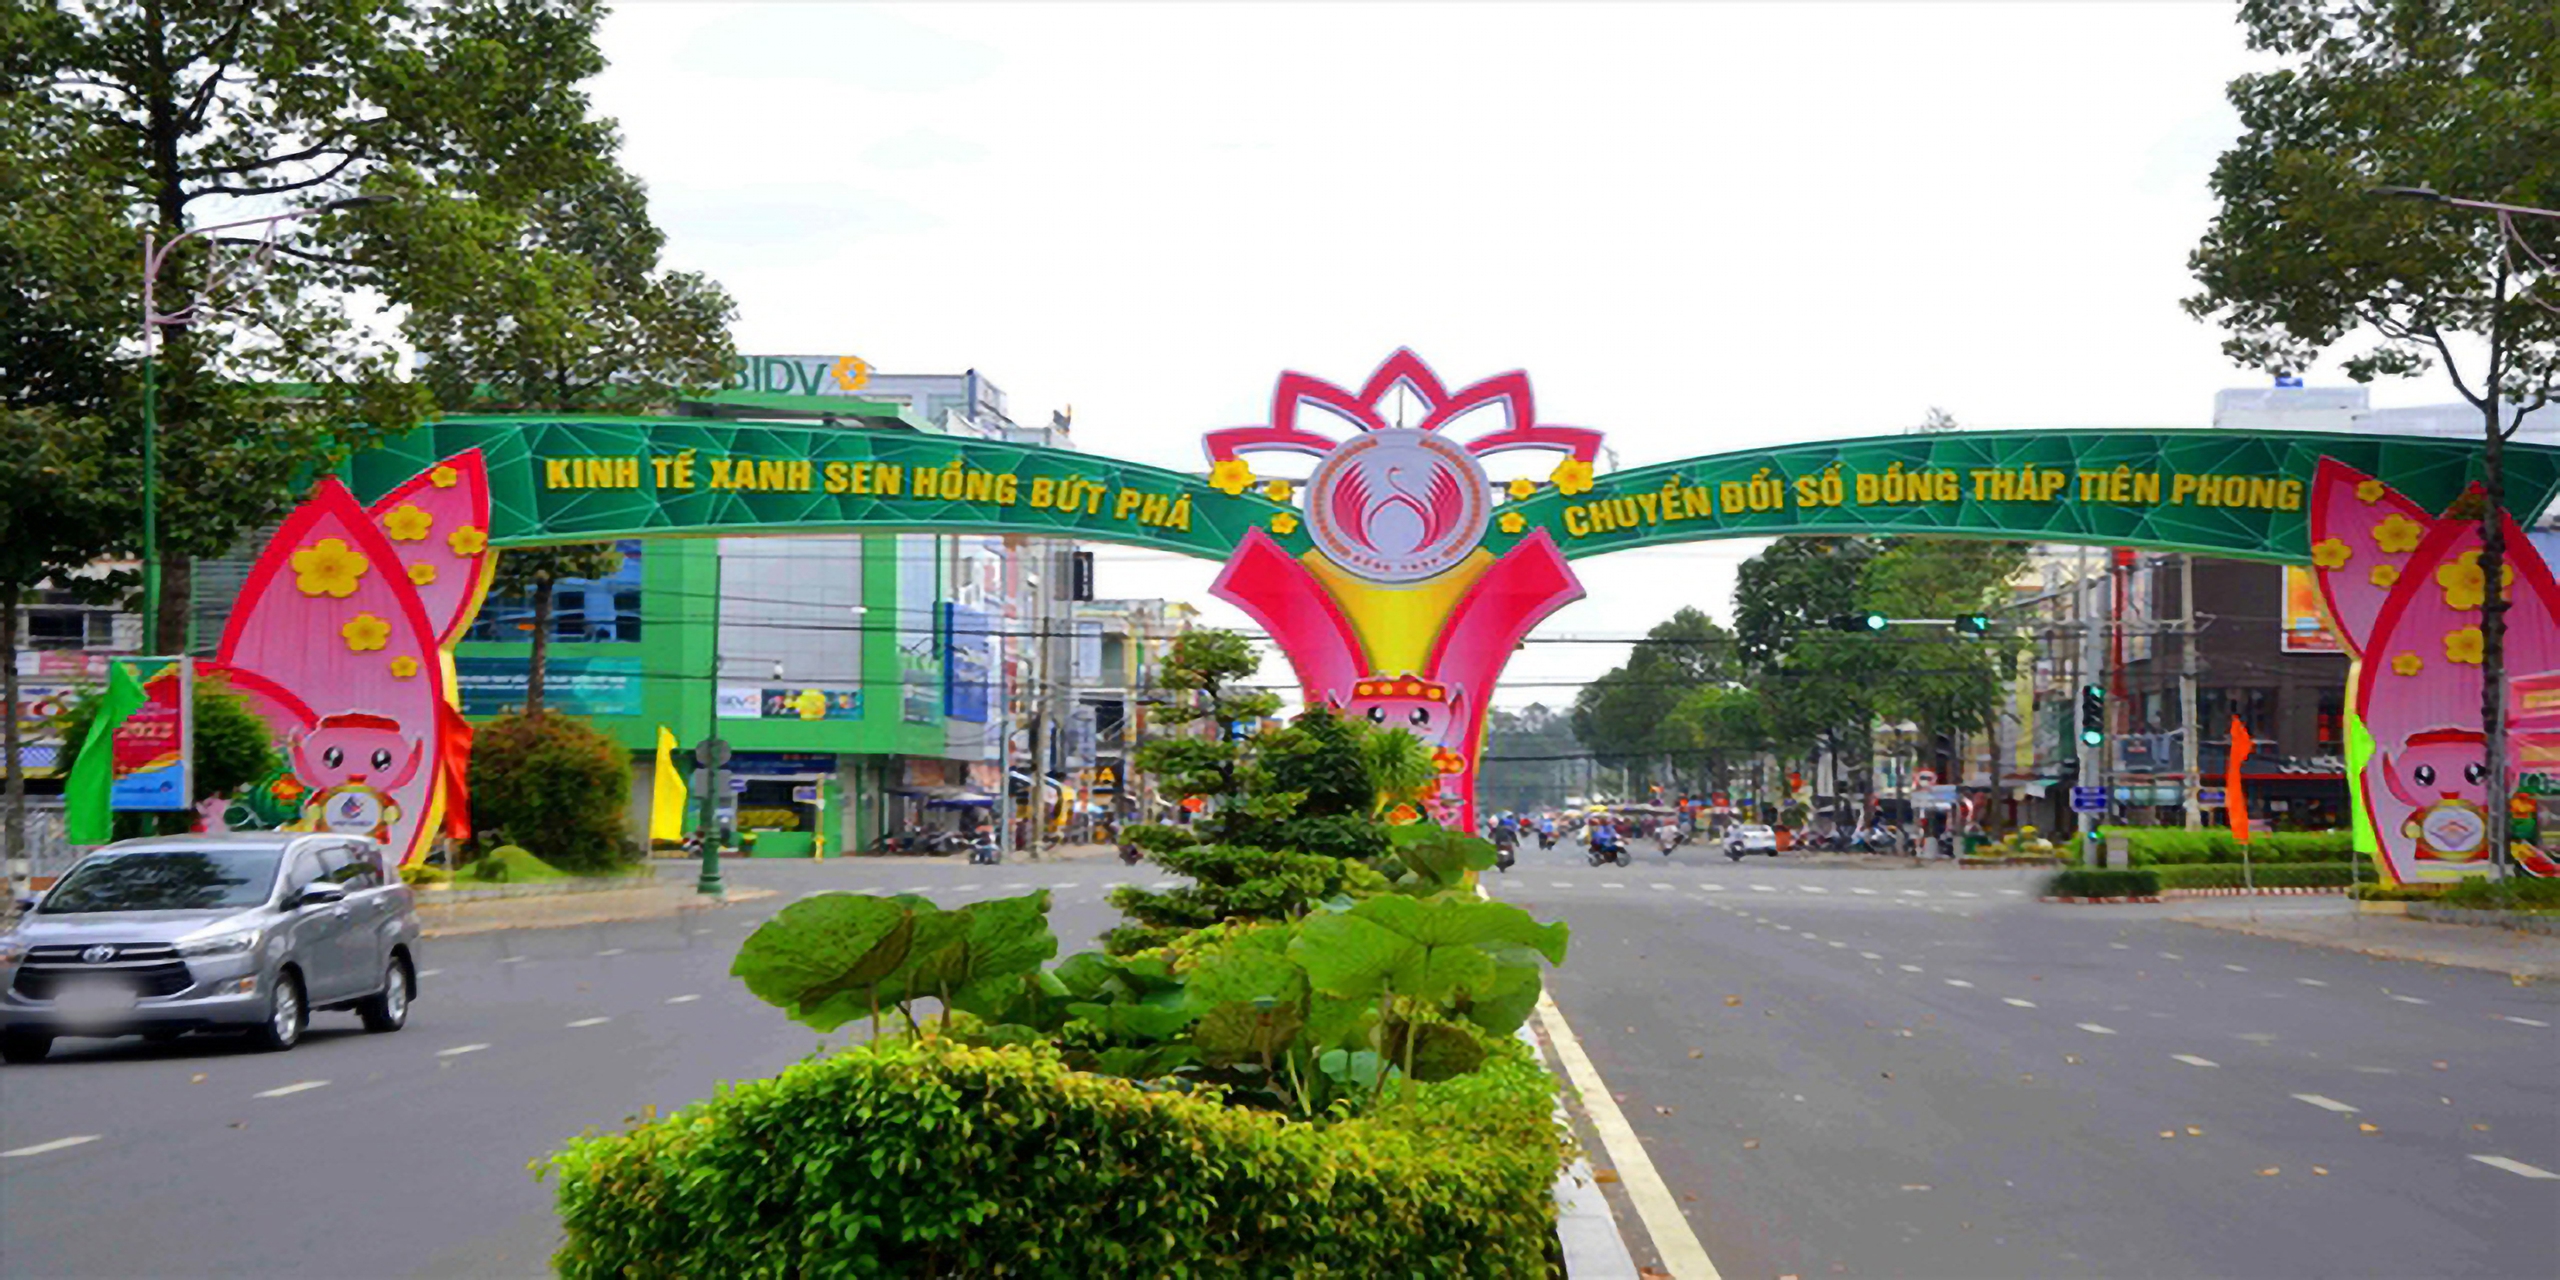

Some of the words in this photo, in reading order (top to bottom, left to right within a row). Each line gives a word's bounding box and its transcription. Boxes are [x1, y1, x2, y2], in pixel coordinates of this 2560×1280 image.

[546, 459, 640, 489] KINH
[651, 446, 697, 489] TẾ
[709, 460, 811, 491] XANH
[823, 461, 904, 495] SEN
[1030, 474, 1106, 515] BỨT
[1112, 488, 1193, 532] PHÁ
[1564, 474, 1713, 537] CHUYỂN
[1720, 468, 1784, 514] ĐỔI
[1796, 462, 1845, 507] SỐ
[1969, 462, 2066, 501] THÁP
[2077, 463, 2161, 503] TIÊN
[2171, 473, 2304, 511] PHONG
